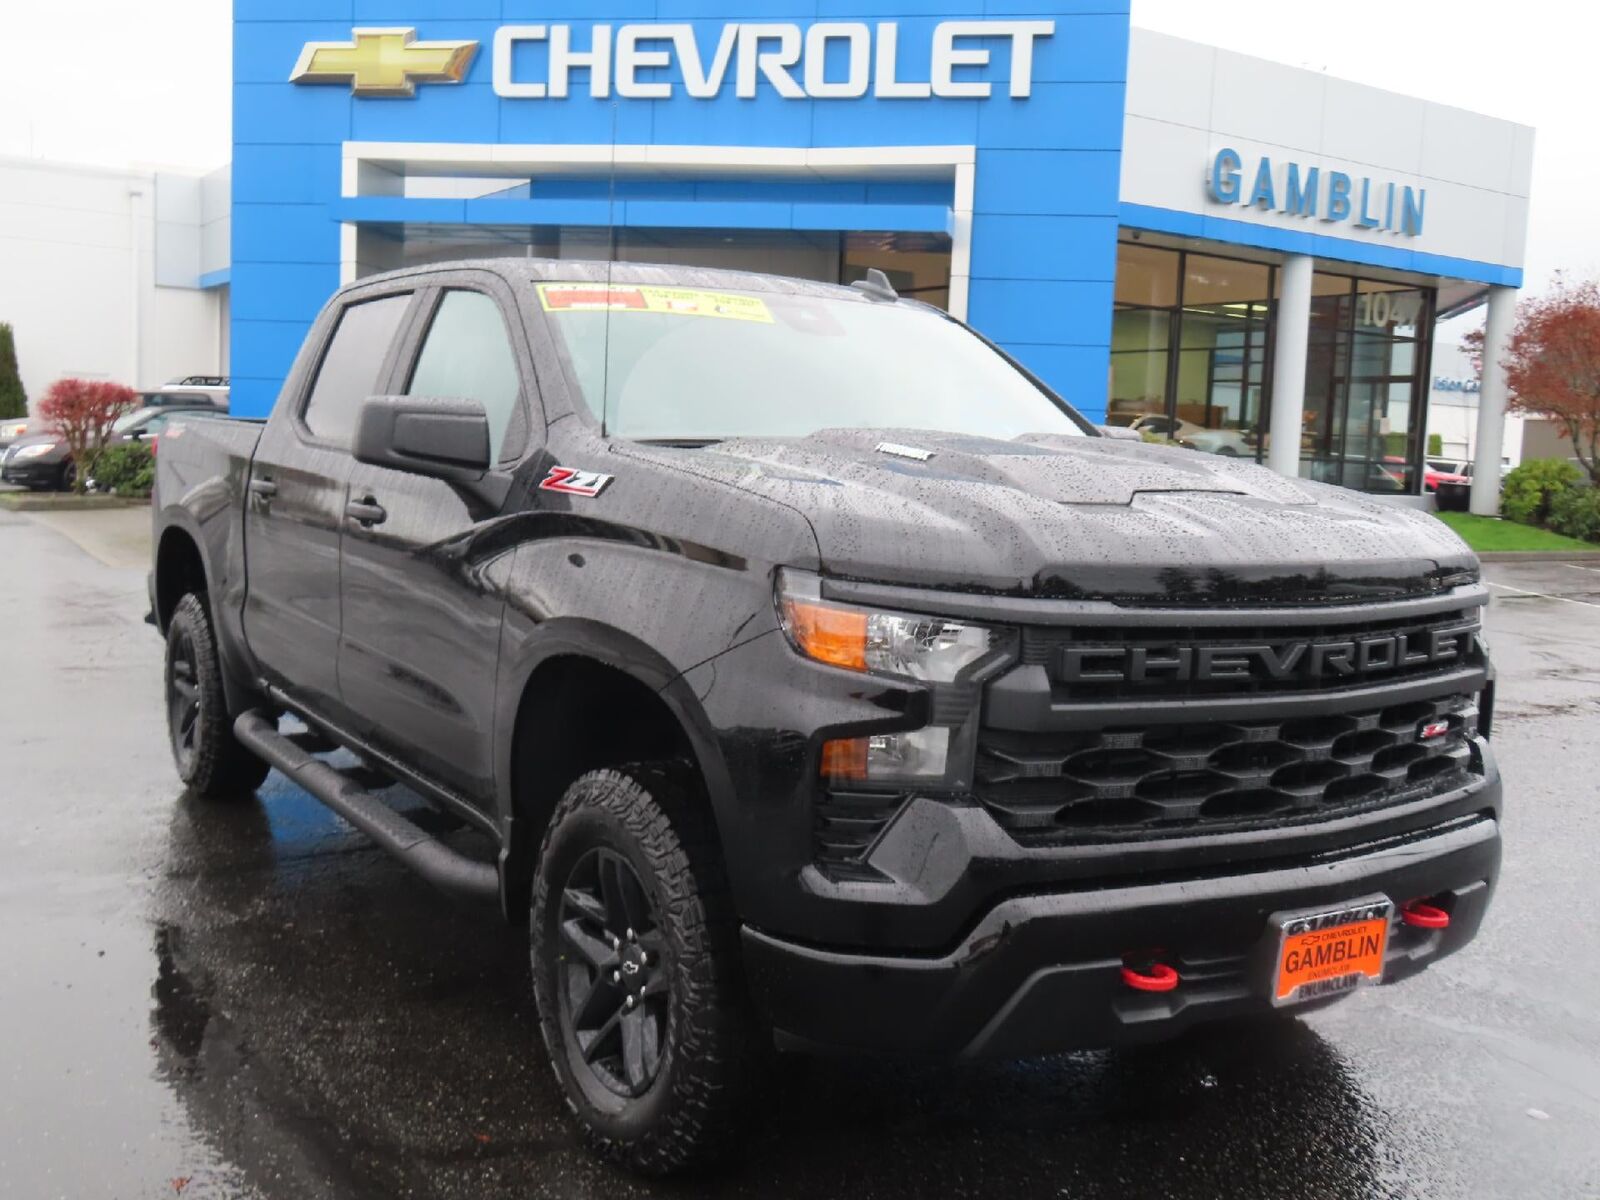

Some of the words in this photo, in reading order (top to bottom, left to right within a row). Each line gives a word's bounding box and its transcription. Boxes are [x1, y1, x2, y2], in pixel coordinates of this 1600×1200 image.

[491, 20, 1056, 100] CHEVROLET
[1209, 147, 1426, 236] GAMBLIN
[1061, 625, 1479, 682] CHEVROLET
[1285, 933, 1380, 974] GAMBLIN
[1322, 926, 1367, 941] CHEVROLET
